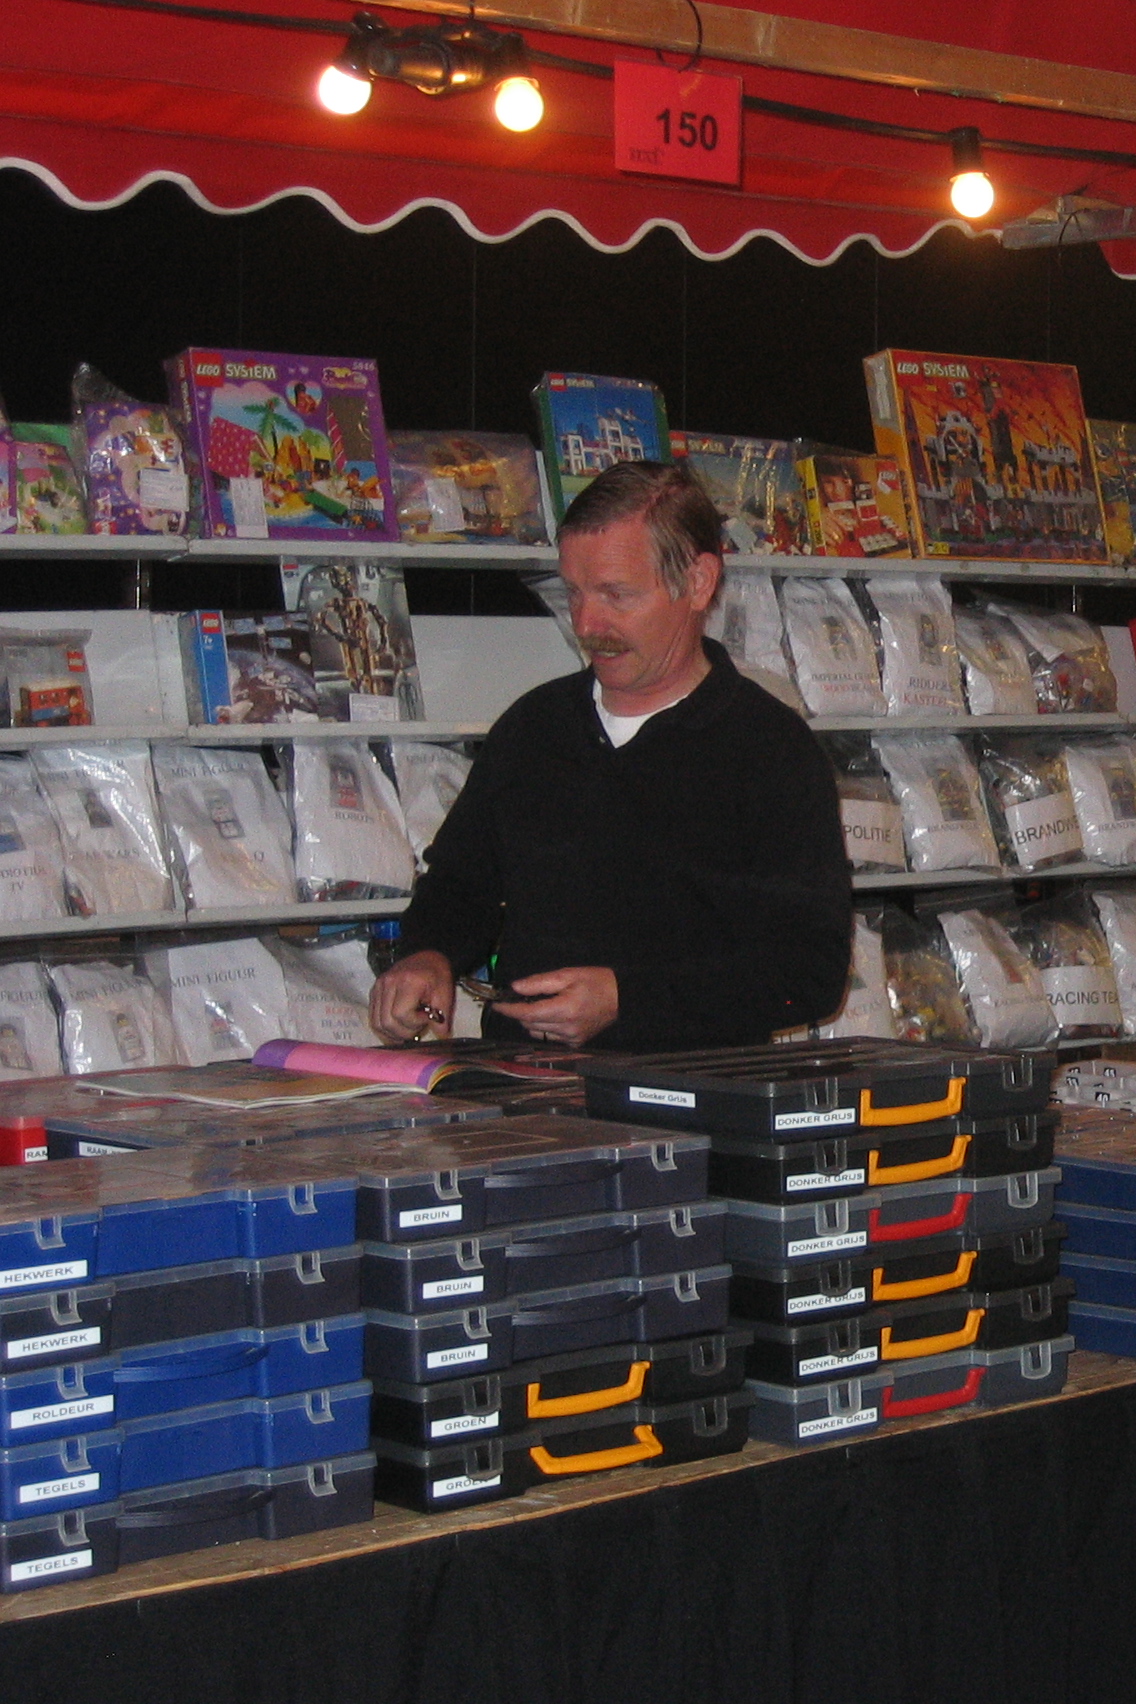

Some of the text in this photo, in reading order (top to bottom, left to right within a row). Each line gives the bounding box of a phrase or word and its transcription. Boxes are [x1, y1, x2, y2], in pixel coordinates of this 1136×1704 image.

[656, 109, 718, 151] 150
[197, 363, 277, 379] LEGO SYSTEM
[897, 362, 970, 379] LEGO SYSTEM
[843, 825, 891, 843] POLITIE
[171, 975, 202, 989] MINI
[207, 968, 256, 984] FIGUUR
[1047, 991, 1099, 1006] RACING
[777, 1112, 853, 1127] DONKER GRIJS
[788, 1172, 863, 1188] DONKER GRIJS
[413, 1210, 451, 1223] BRUIN
[791, 1235, 866, 1254] DONKER GRIJS
[3, 1265, 75, 1285] HEKWERK
[436, 1281, 473, 1294] BRUIN
[789, 1292, 864, 1311] DONKER GRIJS
[21, 1331, 89, 1353] HEKWERK
[440, 1350, 477, 1363] BRUIN
[801, 1351, 876, 1372] DONKER GRIJS
[32, 1402, 95, 1421] ROLDEUR
[445, 1416, 487, 1431] GROEN
[801, 1412, 875, 1435] DONKER GRIJS
[34, 1479, 87, 1497] TEGELS
[26, 1556, 79, 1575] TEGELS
